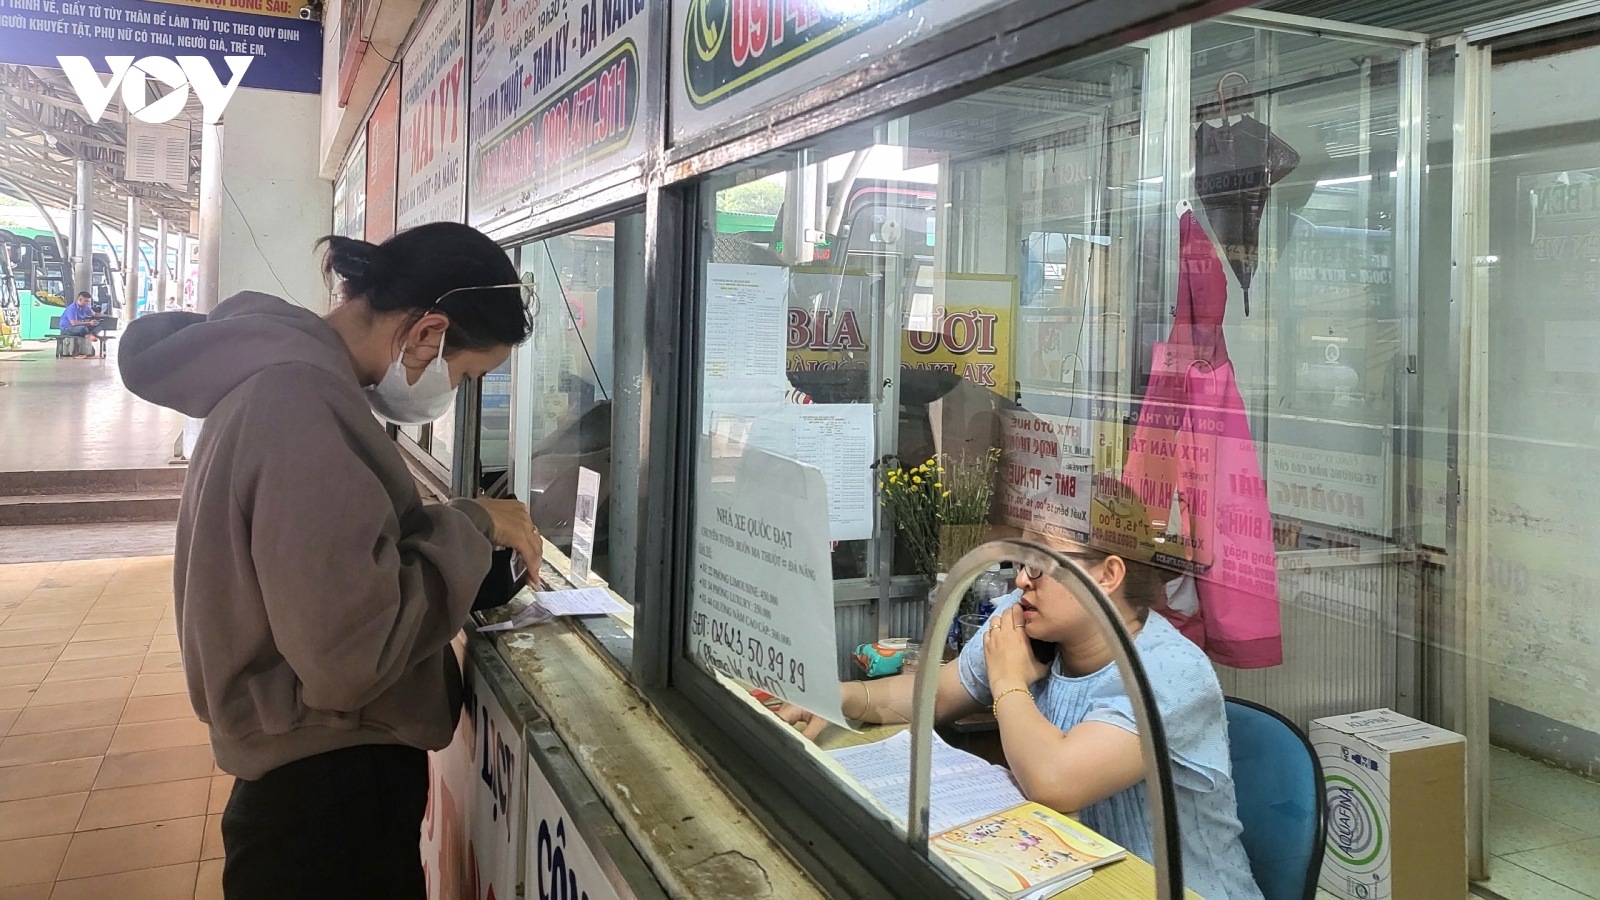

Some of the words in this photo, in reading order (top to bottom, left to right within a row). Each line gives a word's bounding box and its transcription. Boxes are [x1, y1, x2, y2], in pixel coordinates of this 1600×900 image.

[62, 1, 86, 17] GIẤY
[89, 4, 102, 18] TỜ
[104, 6, 122, 21] TÙY
[125, 10, 151, 24] THÂN
[154, 11, 166, 26] ĐỂ
[168, 12, 190, 28] LÀM
[192, 16, 210, 31] THỦ
[212, 20, 230, 34] TỤC
[232, 23, 255, 36] THEO
[258, 26, 275, 39] QUY
[278, 28, 300, 42] ĐỊNH
[266, 0, 291, 14] SAU:
[0, 14, 26, 30] GƯỜI
[30, 18, 70, 34] KHUYẾT
[72, 22, 91, 38] TẬT,
[94, 27, 114, 41] PHỤ
[118, 27, 132, 41] NỮ
[134, 29, 148, 42] CÓ
[151, 32, 174, 46] THAI,
[178, 35, 206, 50] NGƯỜI
[210, 38, 228, 53] GIÀ,
[230, 39, 248, 54] TRẺ
[250, 44, 267, 57] EM,
[509, 35, 522, 64] Xuất
[538, 1, 560, 34] 19h30
[488, 88, 499, 131] MA
[500, 60, 524, 119] THUỘT
[533, 37, 552, 96] TAM
[554, 12, 570, 79] KỲ
[410, 89, 436, 178] MAI
[439, 56, 464, 152] VY
[542, 57, 627, 172] 0906.477.911
[787, 305, 866, 351] BIA
[716, 506, 734, 528] NHÀ
[734, 513, 746, 532] XE
[747, 517, 772, 541] QUỐC
[773, 527, 792, 550] ĐẠT
[736, 539, 750, 556] BUÔN
[750, 546, 761, 559] MA
[761, 550, 782, 567] THUỘT
[788, 560, 798, 575] ĐÀ
[746, 616, 758, 631] CAO
[712, 619, 806, 692] 02623.50.89.89
[1362, 756, 1368, 768] 24
[1339, 787, 1354, 858] AQUAFINA
